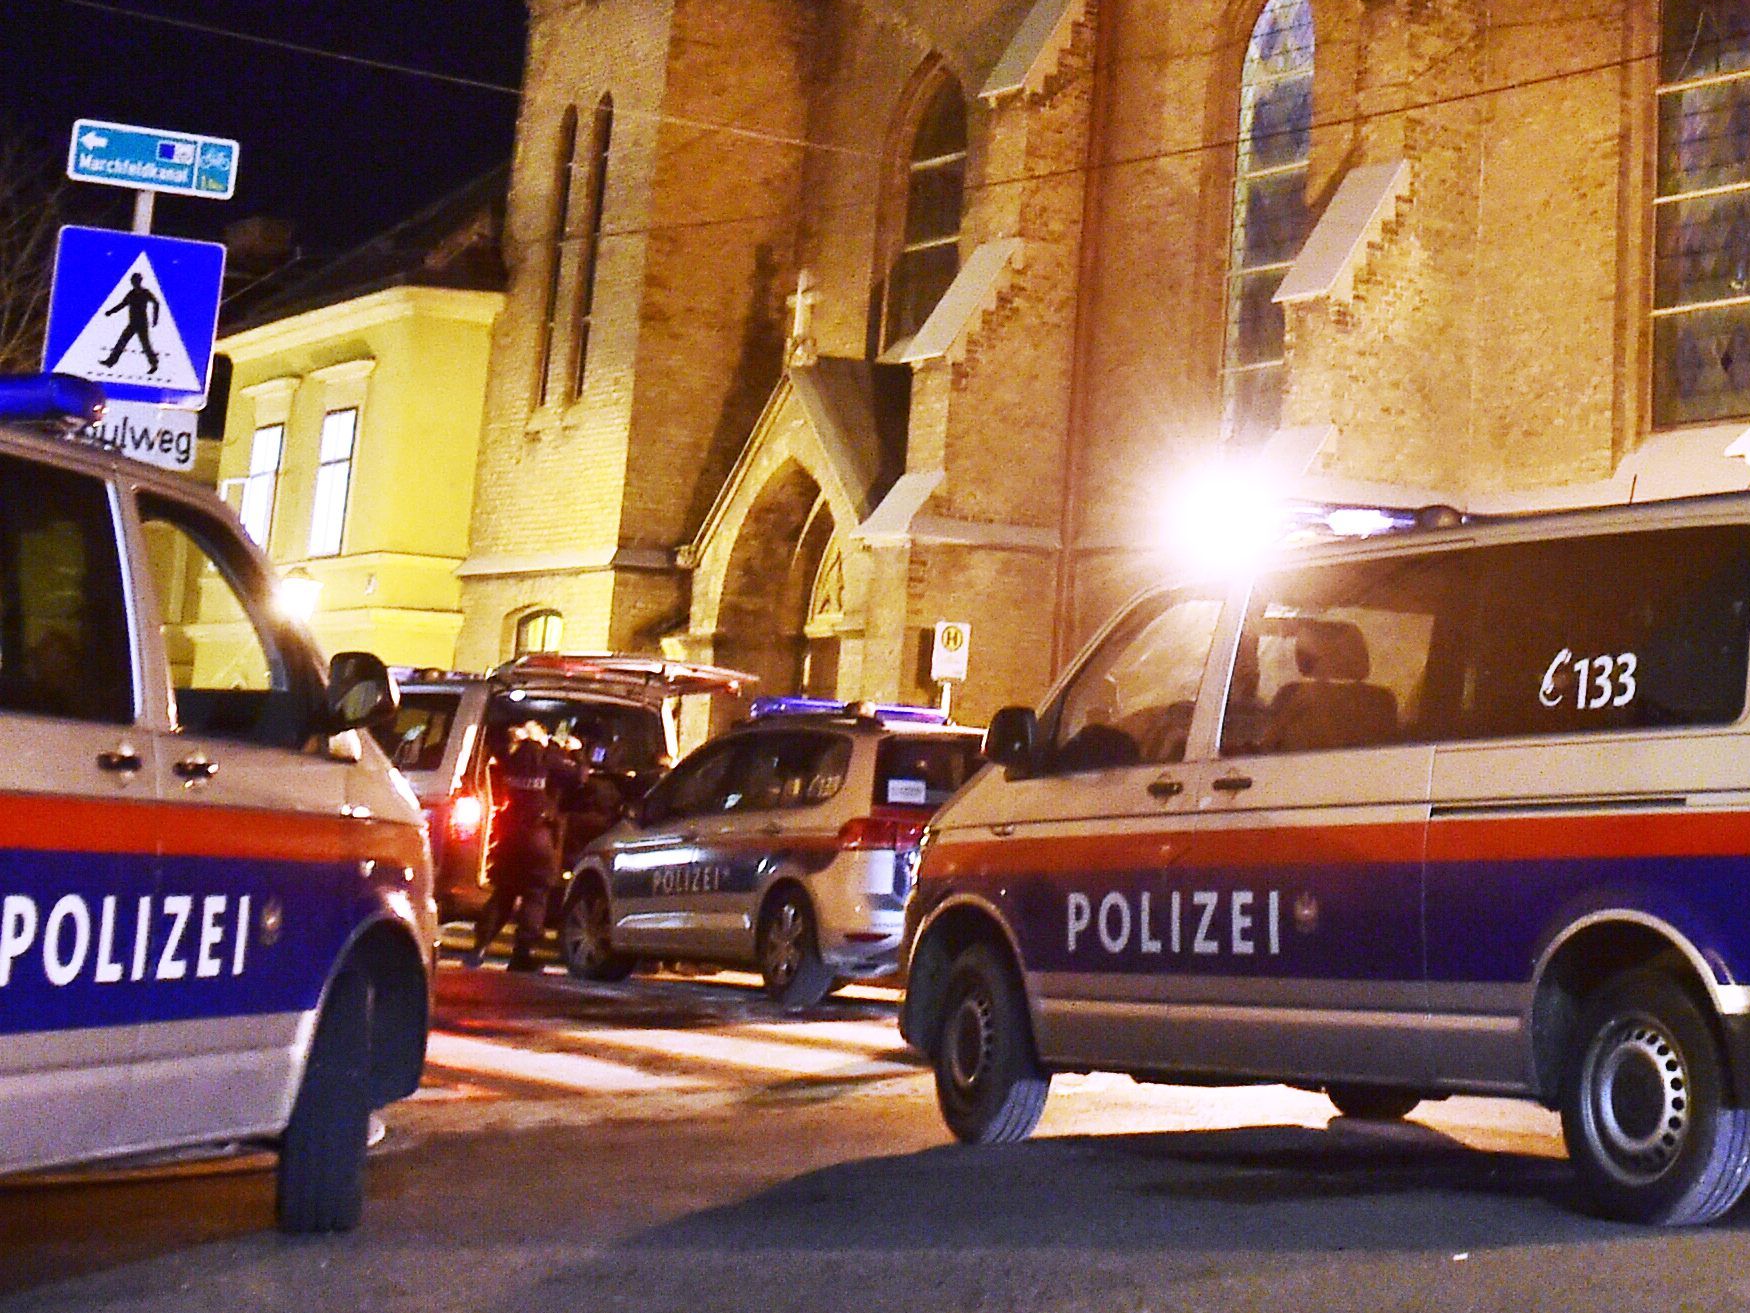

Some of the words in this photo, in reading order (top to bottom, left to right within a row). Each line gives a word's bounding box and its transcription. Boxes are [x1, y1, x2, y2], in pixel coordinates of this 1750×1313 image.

[88, 416, 191, 464] ulweg
[946, 631, 959, 645] H
[1573, 652, 1637, 709] 133
[652, 866, 719, 894] POLIZEI
[0, 894, 250, 986] POLIZEI
[1067, 890, 1280, 954] POLIZEI
